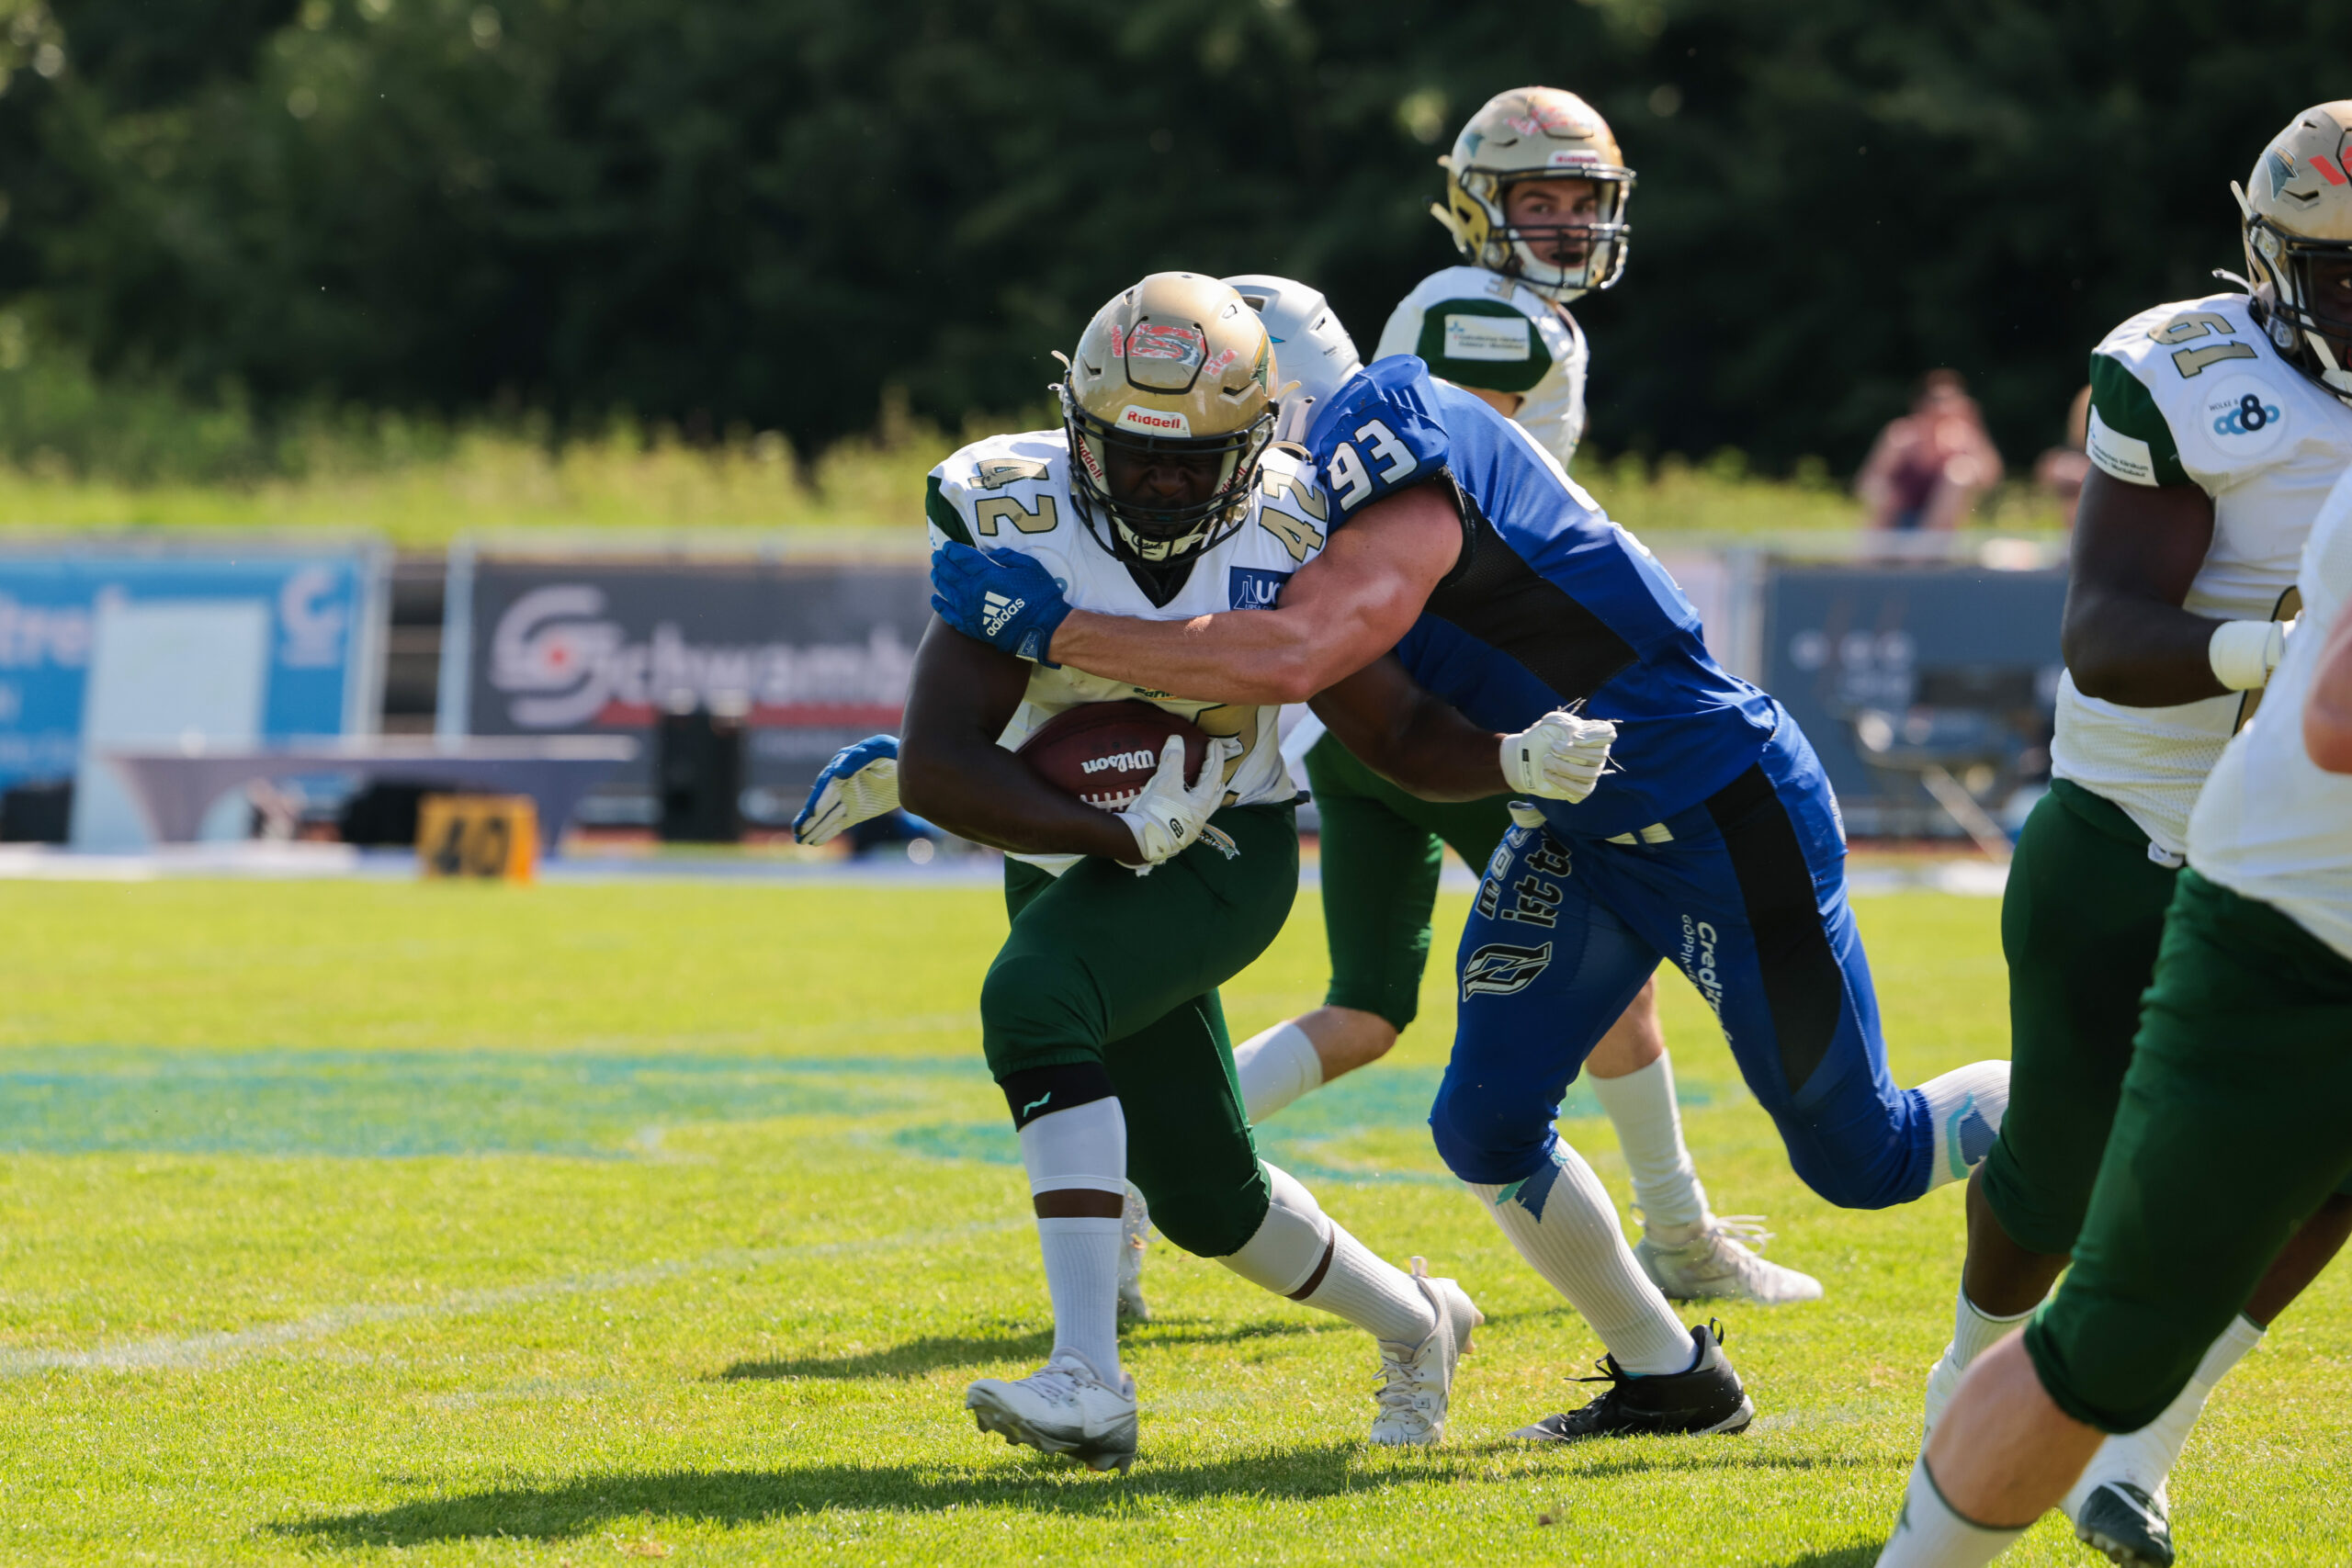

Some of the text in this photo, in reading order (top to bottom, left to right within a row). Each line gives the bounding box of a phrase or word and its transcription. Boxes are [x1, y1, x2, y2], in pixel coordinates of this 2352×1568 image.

[2146, 312, 2258, 378] 61
[1127, 411, 1181, 429] Riddell
[967, 457, 1058, 537] 42
[1326, 418, 1419, 513] 93
[1258, 468, 1329, 564] 42
[986, 598, 1026, 637] adidas
[1081, 750, 1156, 773] Wilson
